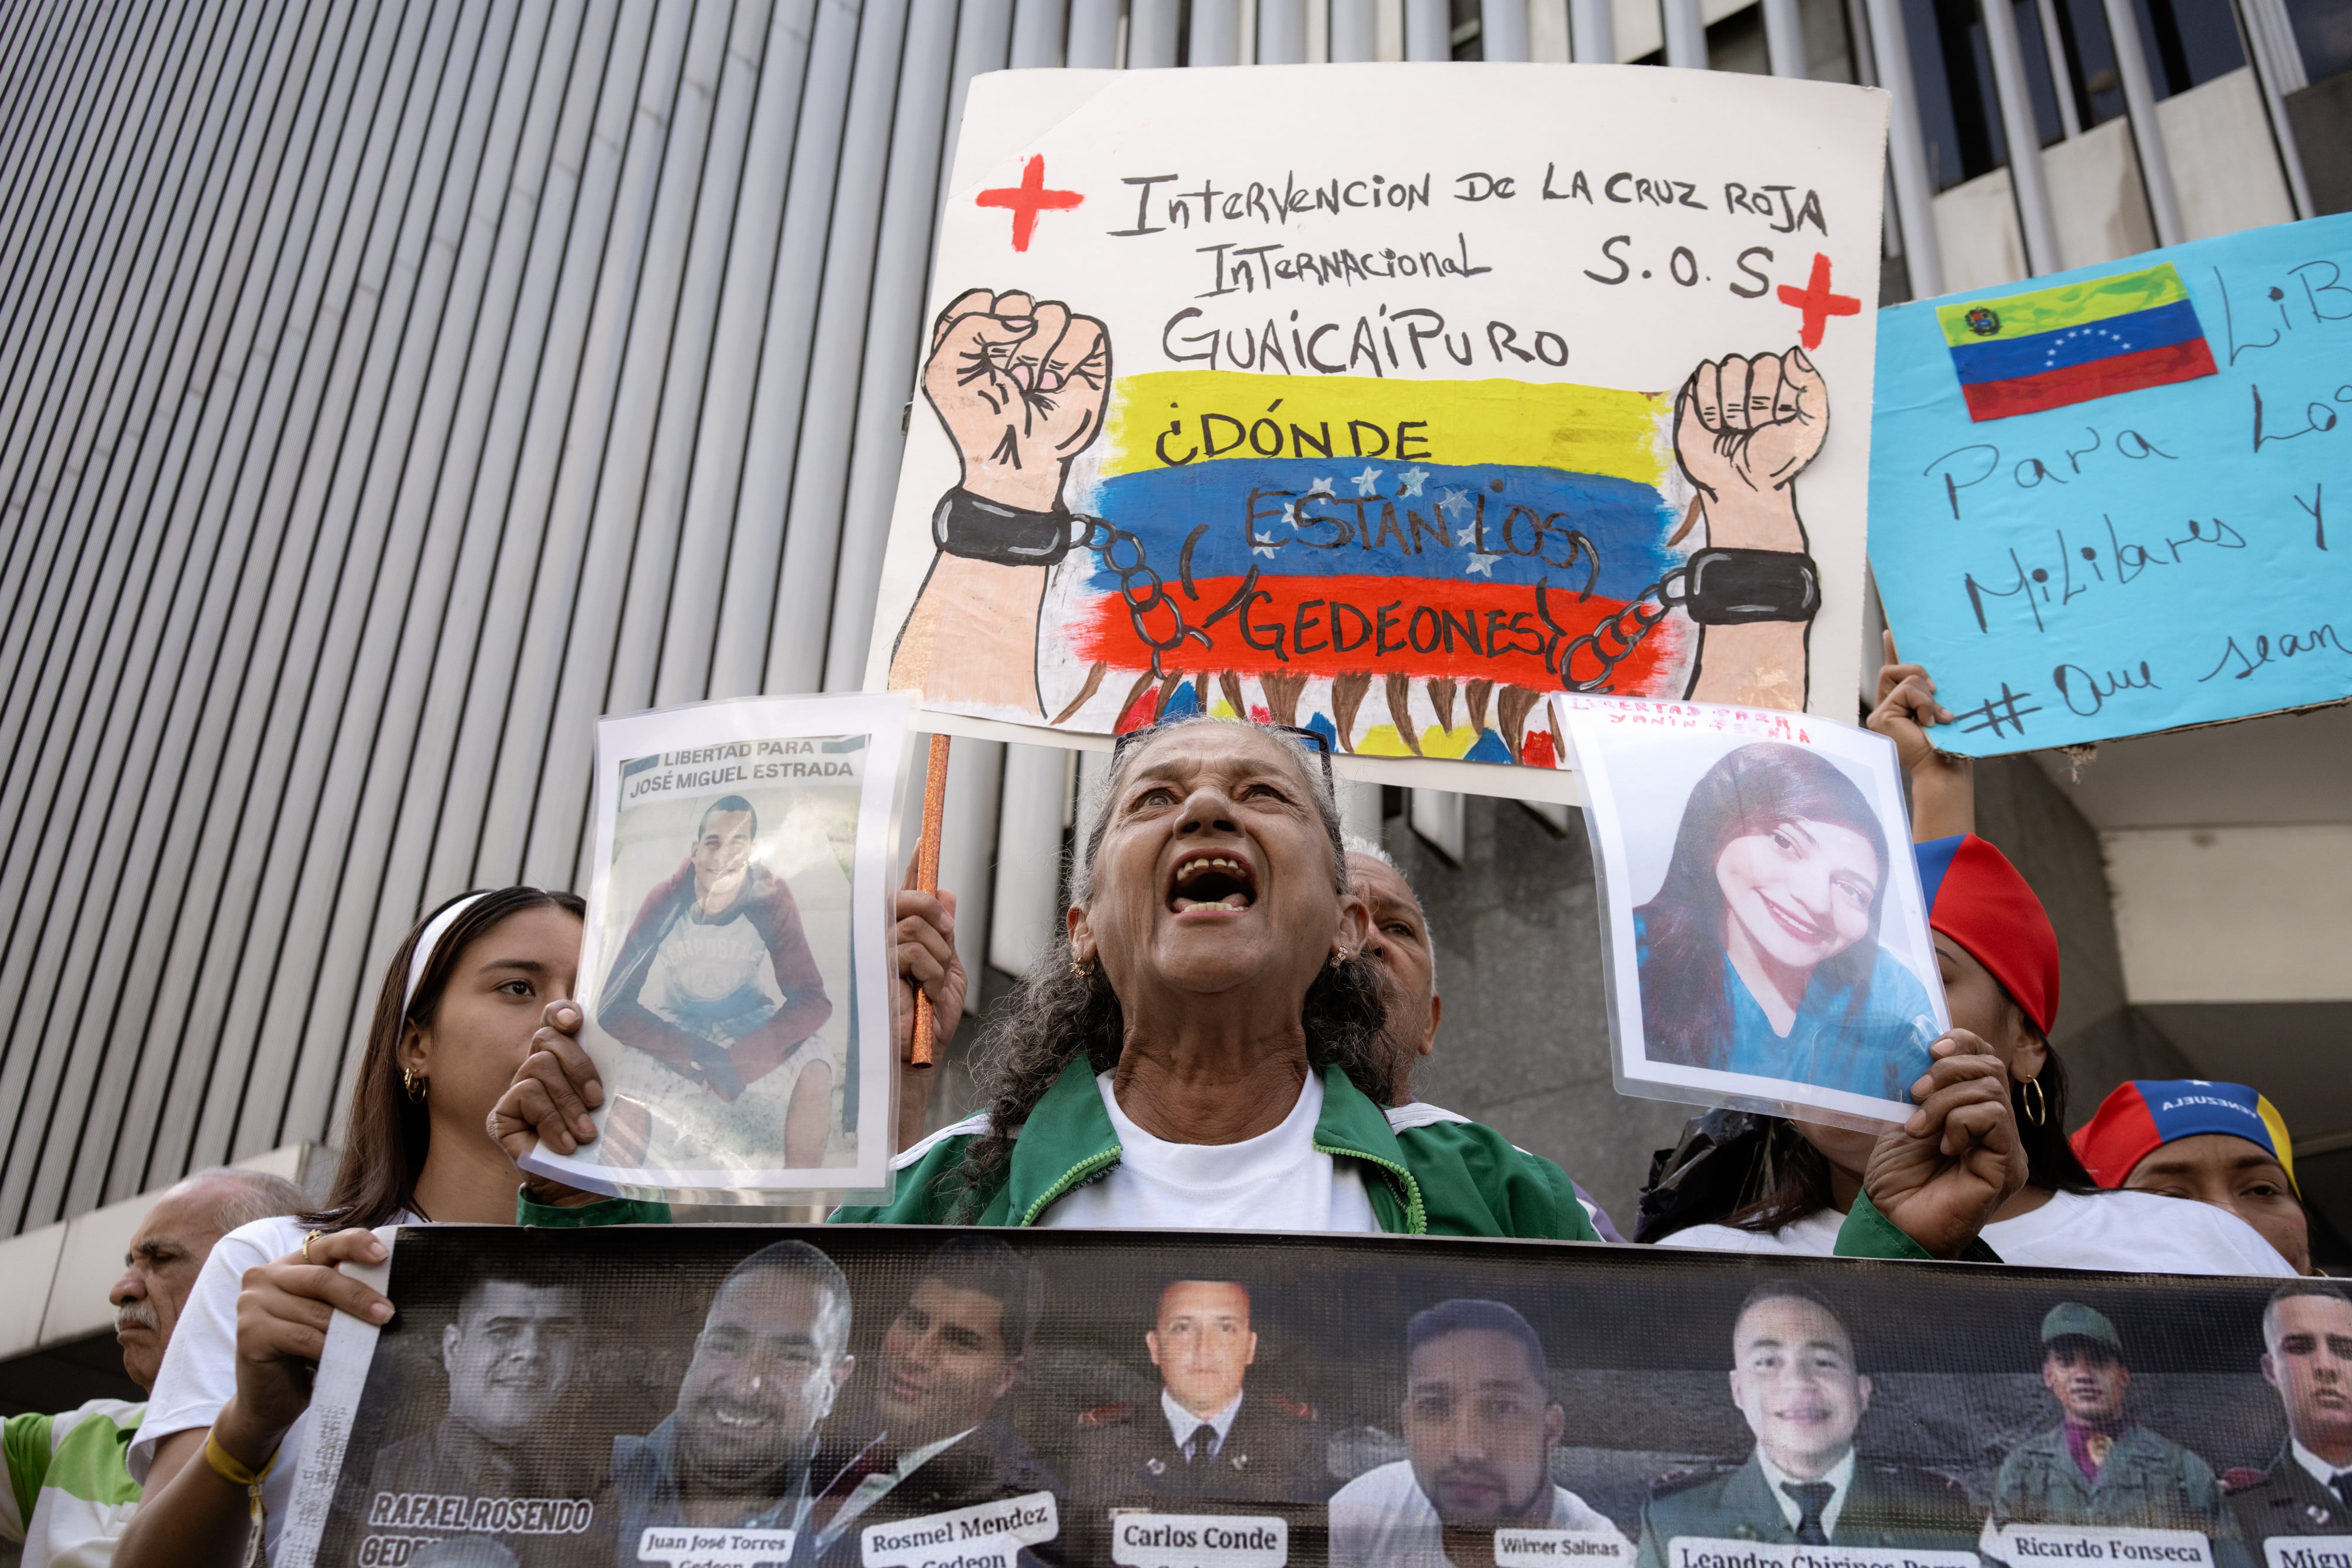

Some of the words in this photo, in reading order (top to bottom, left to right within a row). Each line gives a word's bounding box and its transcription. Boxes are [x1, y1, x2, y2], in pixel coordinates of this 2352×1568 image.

[1604, 172, 1709, 210] CRUZ
[1155, 398, 1432, 467] ¿DÓNDE
[1923, 426, 2179, 520] Para
[2294, 483, 2327, 551] Y
[664, 742, 752, 767] LIBERTAD
[756, 741, 814, 755] PARA
[630, 771, 673, 798] JOSÉ
[676, 766, 748, 790] MIGUEL
[753, 762, 854, 779] ESTRADA
[369, 1492, 468, 1530] RAFAEL
[470, 1497, 593, 1533] ROSENDO
[873, 1522, 954, 1552] Rosmel
[960, 1507, 1048, 1540] Mendez
[359, 1534, 442, 1568] GED
[646, 1533, 687, 1551] Juan
[690, 1534, 726, 1552] José
[731, 1536, 787, 1550] Torres
[1124, 1525, 1197, 1547] Carlos
[1204, 1527, 1278, 1550] Conde
[1502, 1537, 1557, 1554] Wilmer
[1562, 1539, 1621, 1557] Salinas
[2015, 1537, 2103, 1559] Ricardo
[2109, 1539, 2202, 1562] Fonseca
